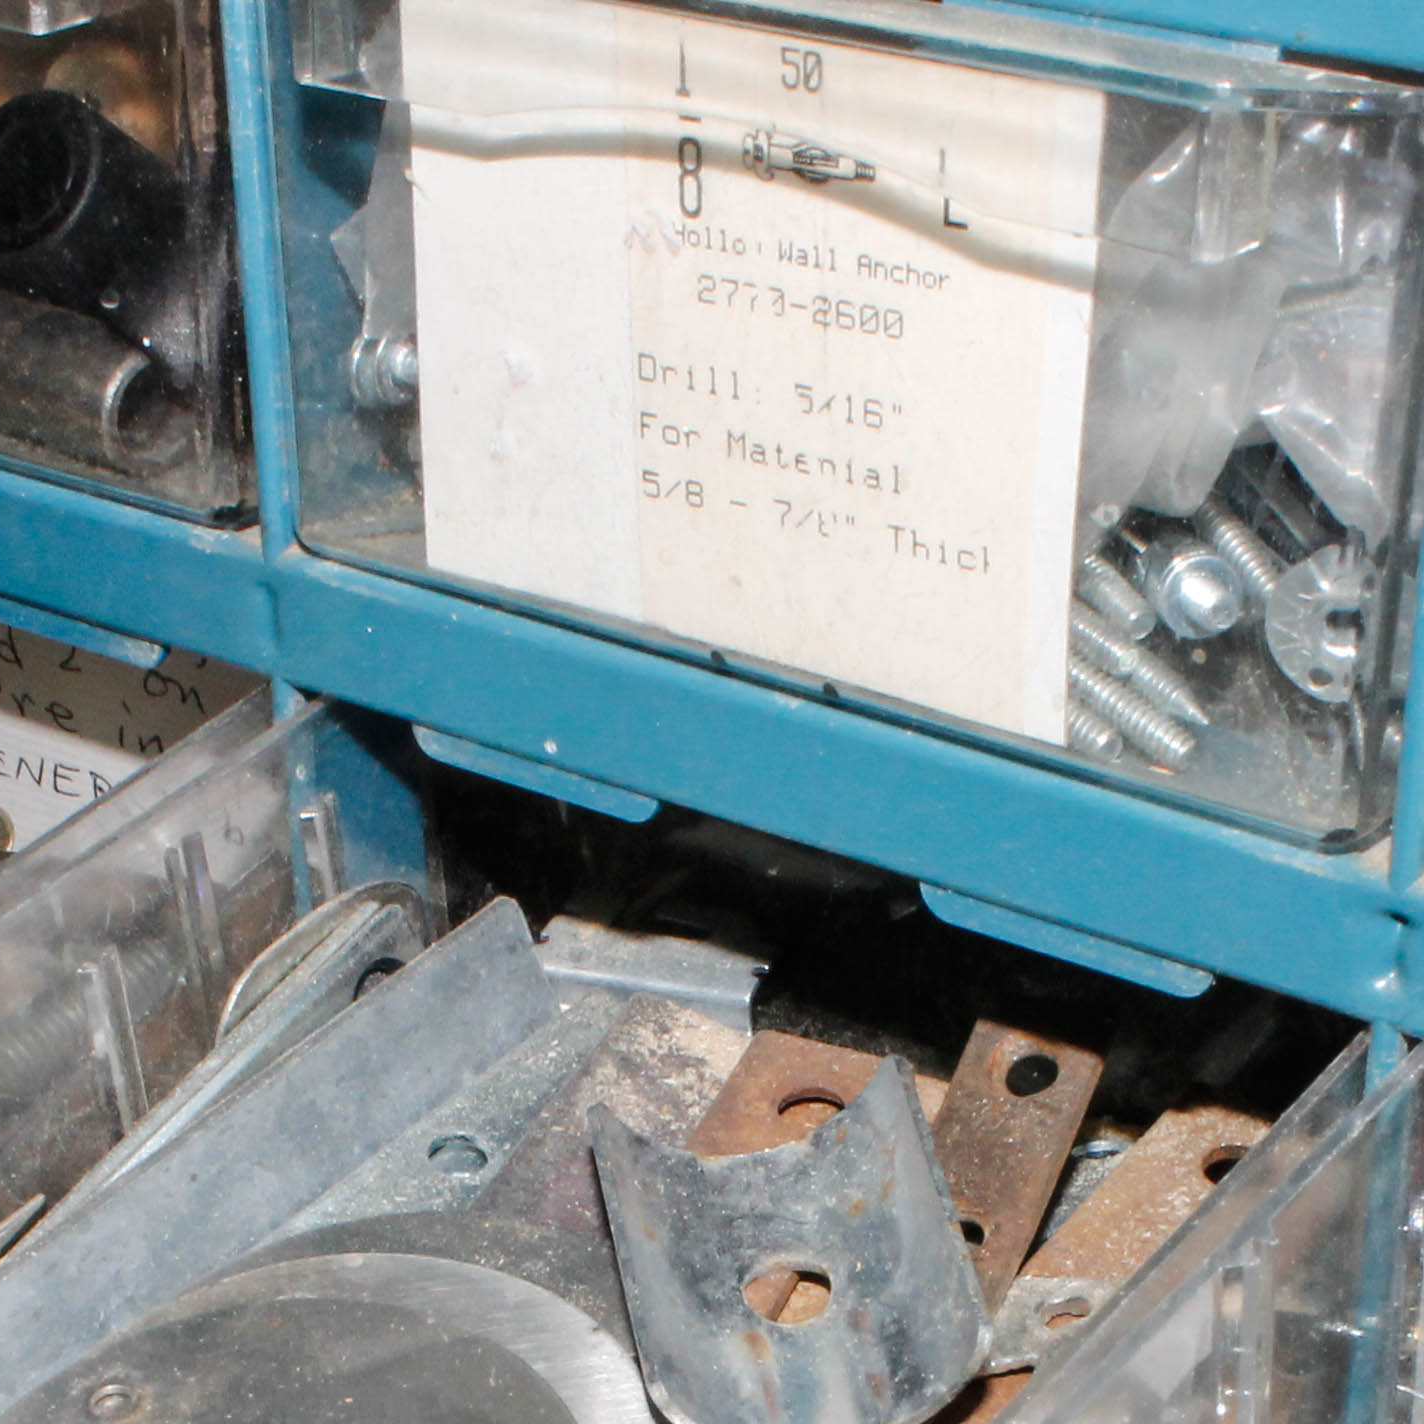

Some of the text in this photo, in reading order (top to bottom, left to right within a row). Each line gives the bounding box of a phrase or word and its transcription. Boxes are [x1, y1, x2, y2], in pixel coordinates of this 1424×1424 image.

[779, 45, 824, 93] 50
[672, 221, 952, 292] Hollo Wall Anchor
[639, 410, 702, 449] For
[641, 469, 705, 509] 5/8
[118, 701, 164, 753] in
